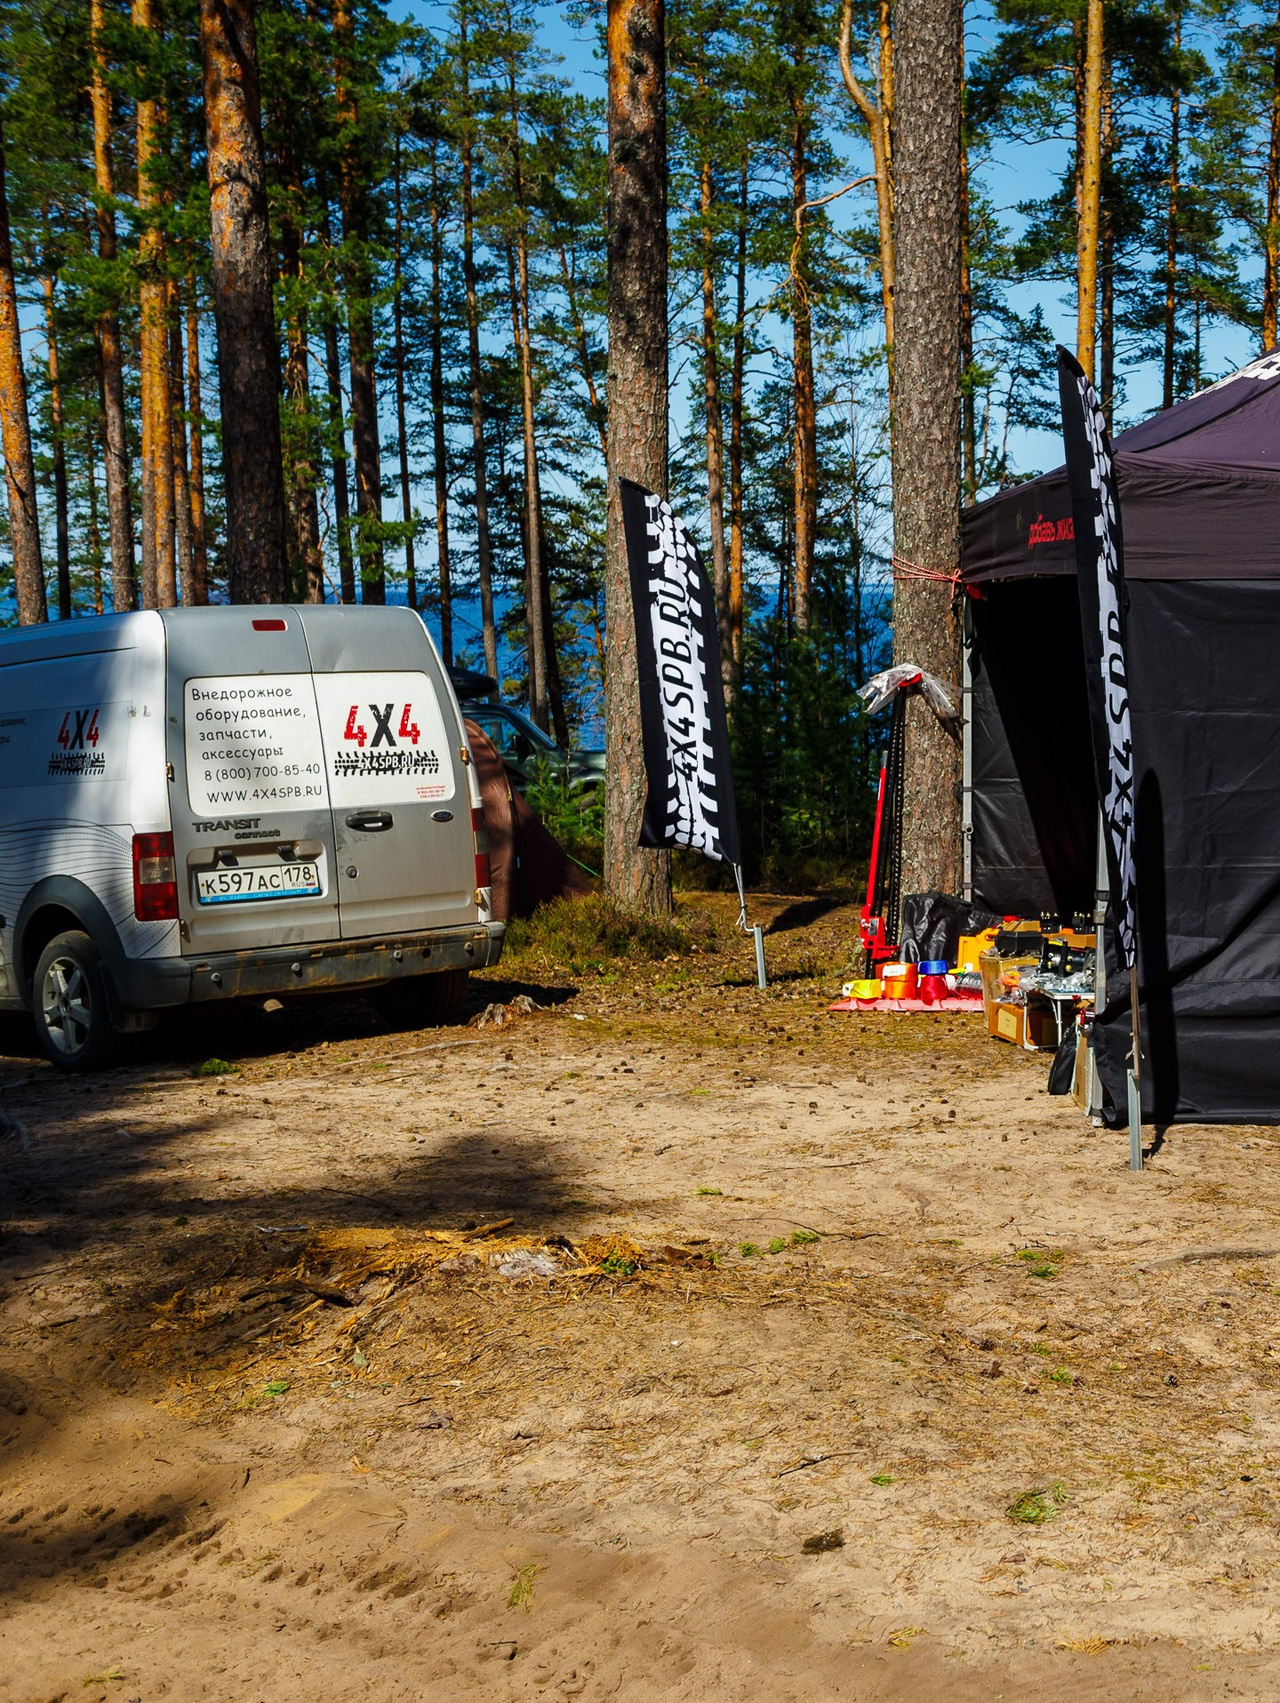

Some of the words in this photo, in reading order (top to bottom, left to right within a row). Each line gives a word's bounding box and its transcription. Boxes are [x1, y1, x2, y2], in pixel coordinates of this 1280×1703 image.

[658, 576, 699, 782] 4X4SPB.RU
[192, 688, 293, 702] Внедорожное
[196, 707, 306, 723] оборудование,
[57, 709, 100, 750] 4X4
[344, 703, 420, 747] 4X4
[199, 729, 272, 741] запчасти,
[202, 747, 284, 760] аксессуары
[358, 755, 415, 770] 4X4SPB.RU
[204, 770, 212, 781] 8
[216, 767, 251, 782] (800)
[254, 763, 320, 778] 700-85-40
[207, 785, 322, 803] WWW.4X4SPB.RU
[192, 818, 261, 832] TRANSIT
[234, 829, 281, 840] connect
[284, 866, 311, 882] 178
